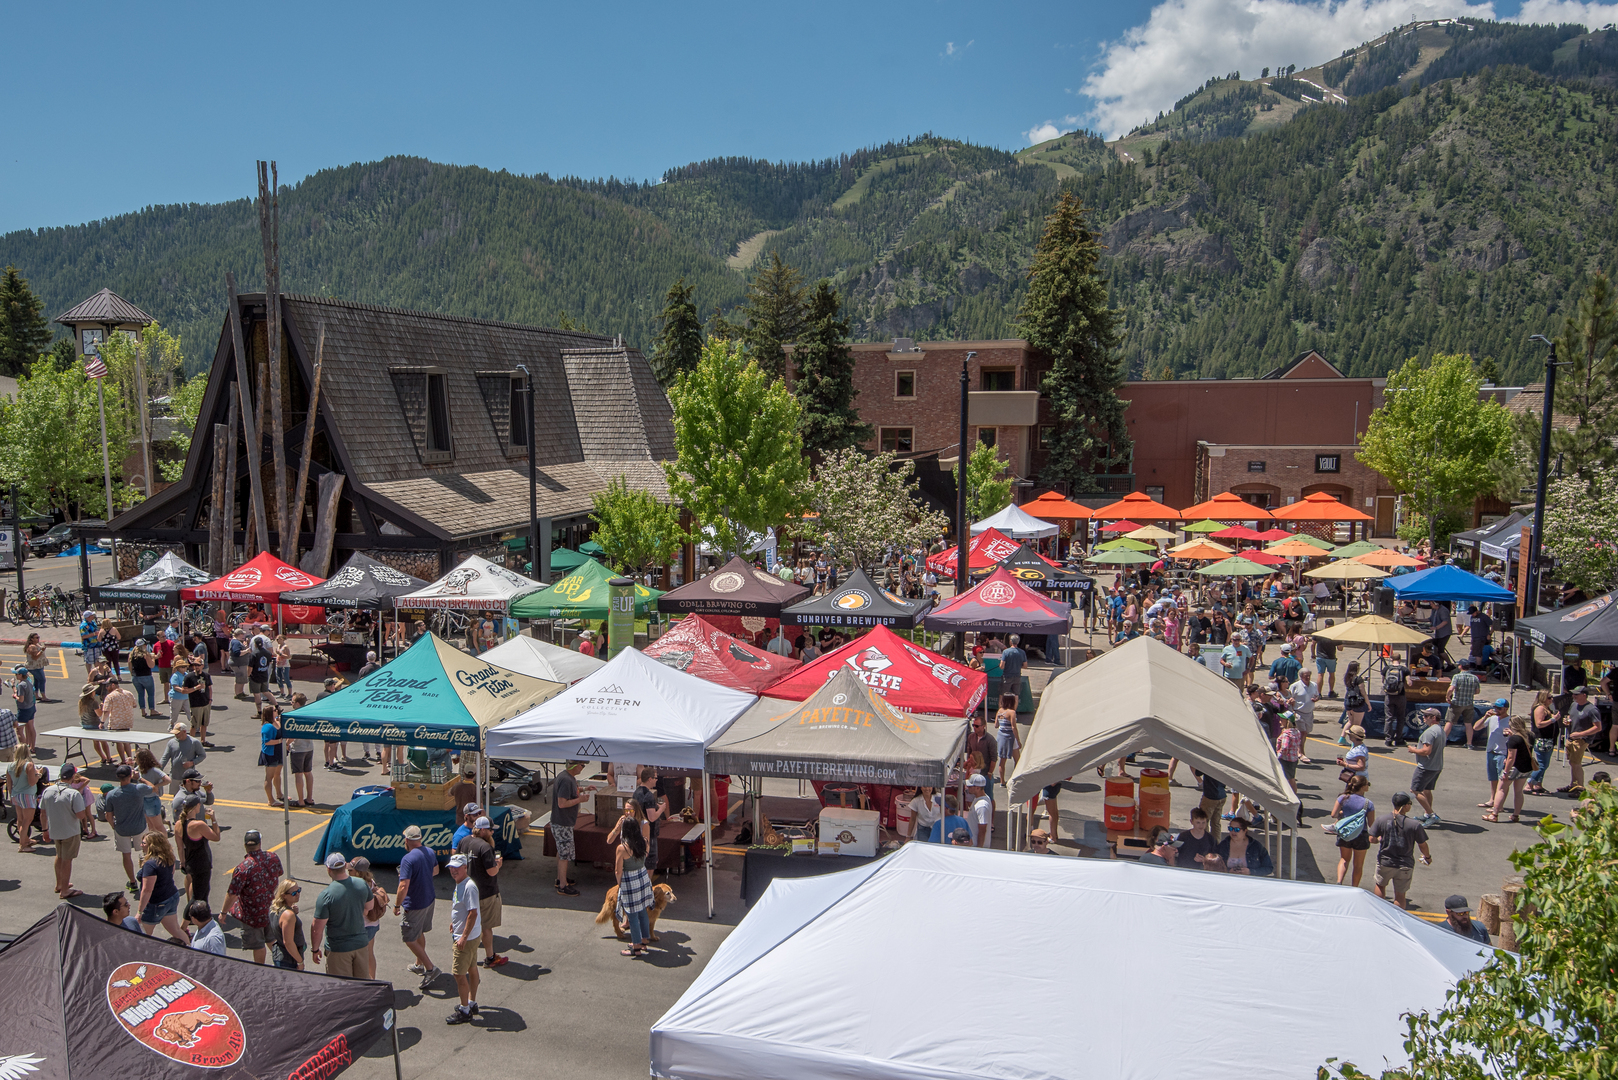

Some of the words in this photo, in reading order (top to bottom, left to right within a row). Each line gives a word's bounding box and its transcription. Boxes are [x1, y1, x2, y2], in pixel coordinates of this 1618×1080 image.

[1046, 580, 1090, 590] Brewing
[195, 590, 232, 600] UINTA
[395, 598, 448, 608] LAGUNITAS
[448, 598, 490, 610] BREWING
[796, 615, 842, 624] SUNRIVER
[846, 616, 888, 626] BREWING
[364, 670, 438, 690] Grand
[456, 664, 500, 686] Grand
[827, 670, 902, 690] SKEYE
[360, 688, 413, 704] Teton
[477, 679, 514, 698] Teton
[501, 688, 520, 698] BREWING
[576, 698, 641, 706] WESTERN
[799, 706, 875, 728] PAYETTE
[284, 718, 316, 732] Grand
[316, 720, 341, 734] Teton
[348, 721, 380, 736] Grand
[380, 724, 408, 738] Teton
[414, 726, 449, 742] Grand
[449, 728, 476, 743] Teton
[352, 824, 405, 850] Gran
[420, 824, 454, 846] Teto
[144, 970, 174, 989] BREWING
[119, 994, 168, 1027] Mighty
[155, 978, 196, 1003] Bison
[190, 1050, 234, 1064] Brown
[228, 1031, 242, 1052] Ale
